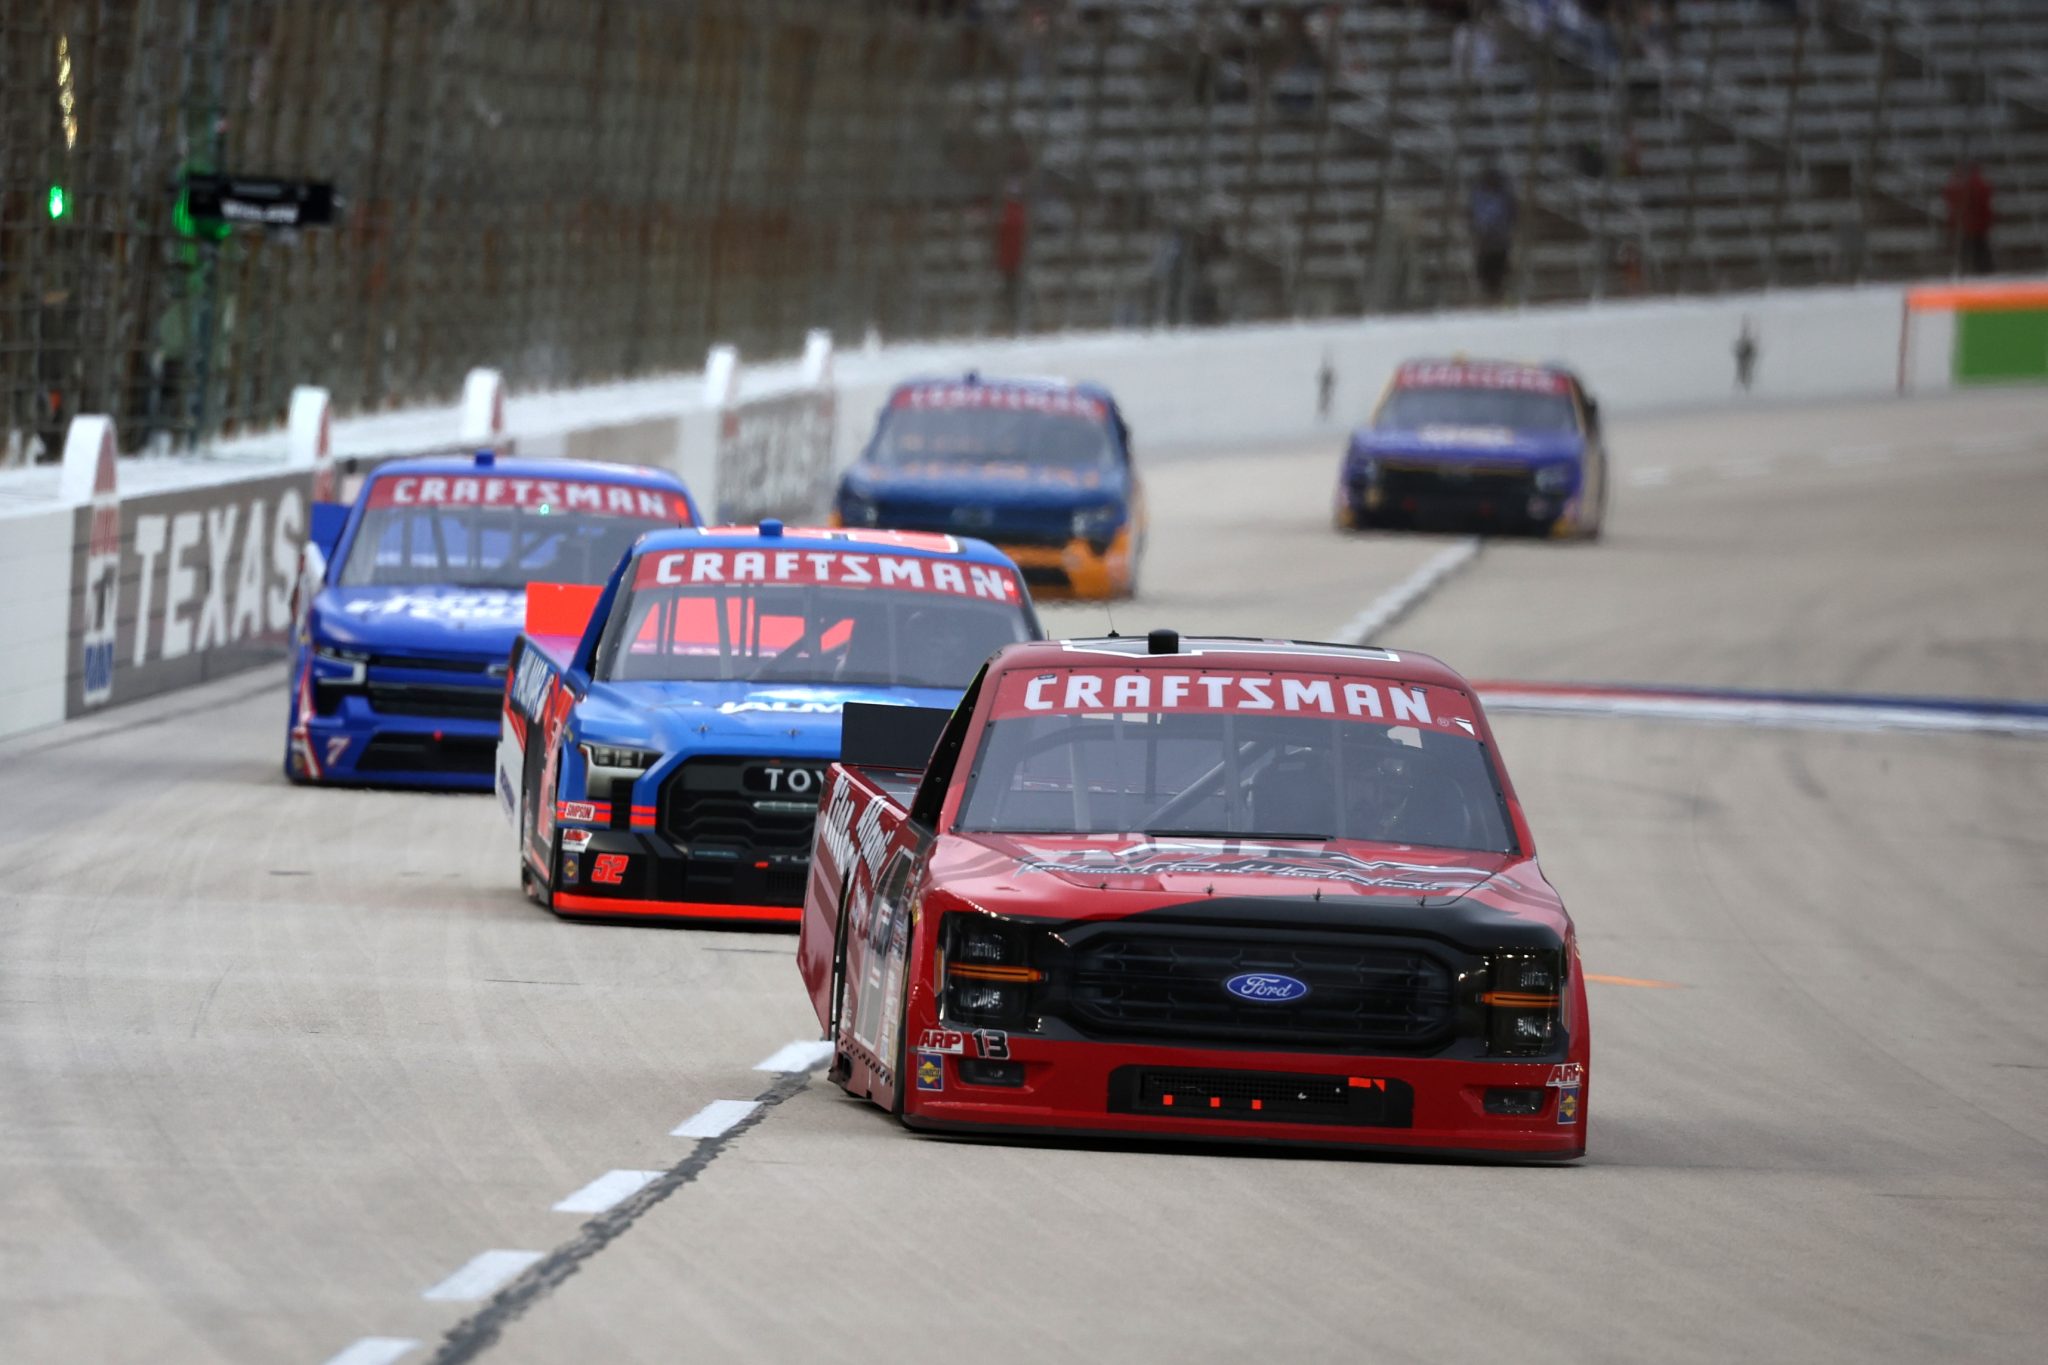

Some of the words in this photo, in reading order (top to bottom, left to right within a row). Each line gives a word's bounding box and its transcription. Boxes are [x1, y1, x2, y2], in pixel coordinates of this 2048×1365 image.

[392, 477, 668, 519] CRAFTSMAN
[133, 487, 304, 669] TEXAS
[655, 550, 1007, 600] CRAFTSMAN
[1023, 674, 1433, 725] CRAFTSMAN
[326, 735, 352, 769] 7
[591, 853, 630, 885] 52
[1240, 976, 1292, 997] Ford
[919, 1029, 963, 1051] ARP
[972, 1028, 1010, 1060] 13
